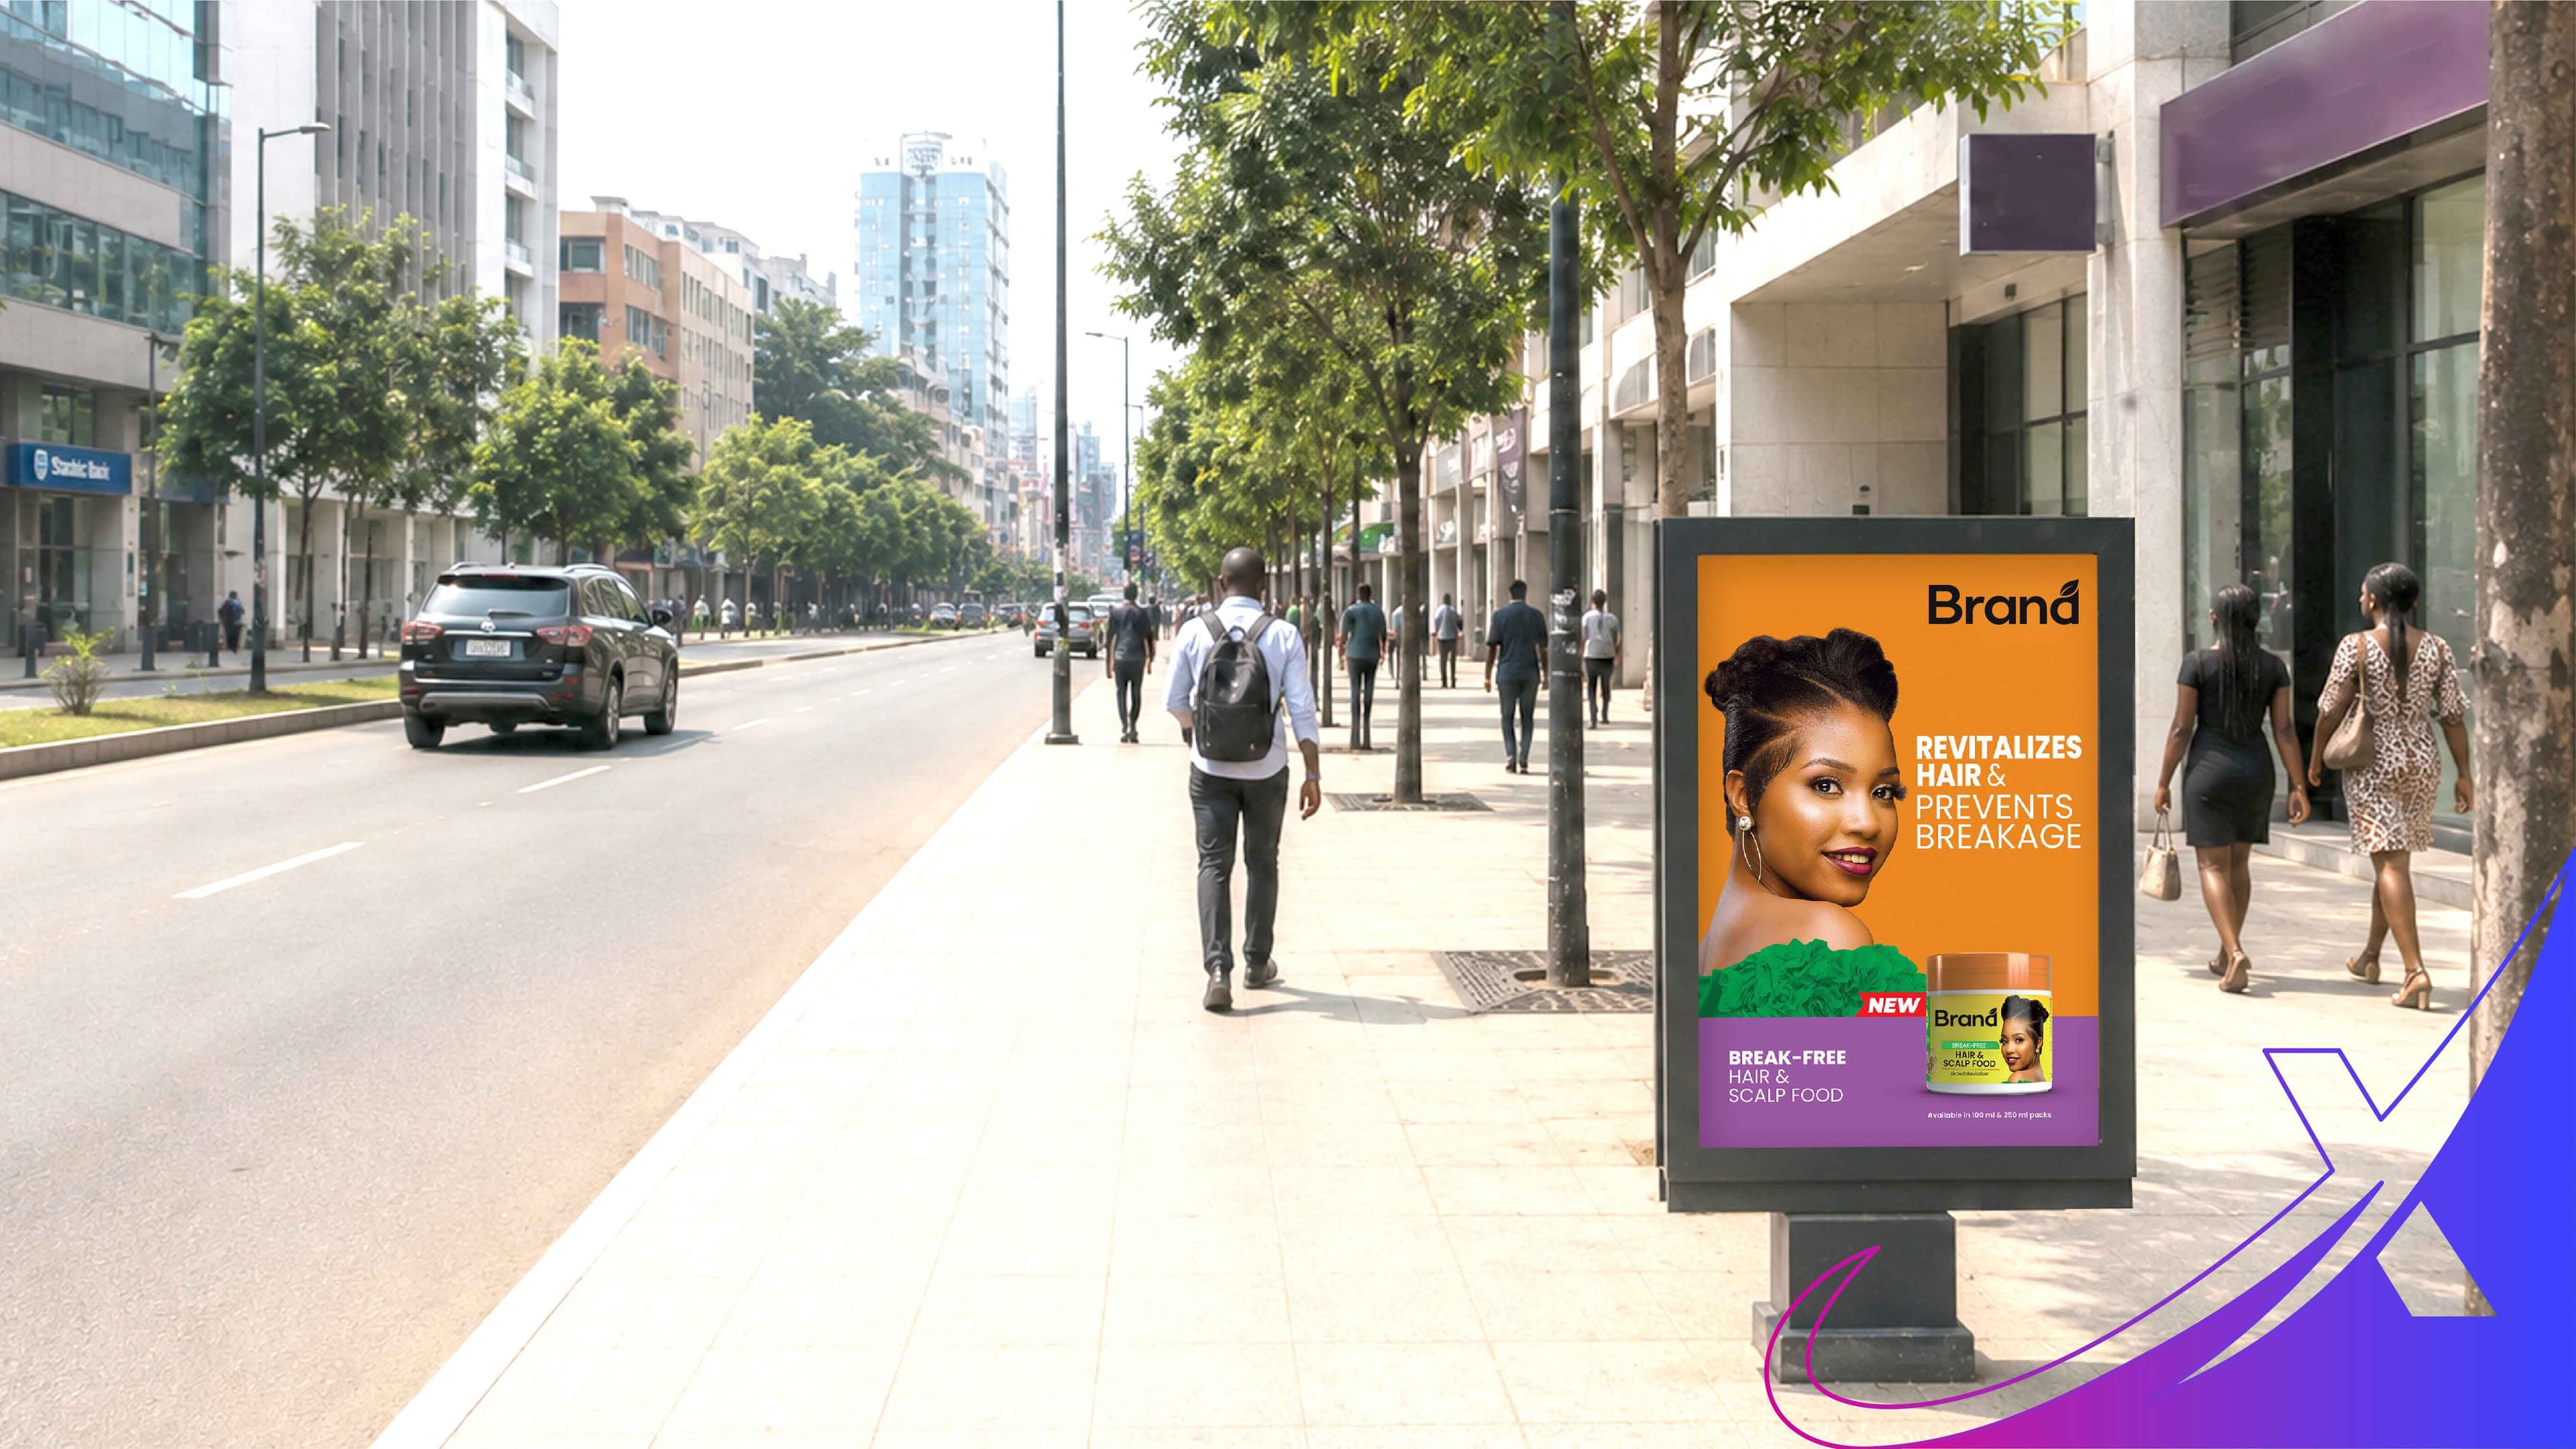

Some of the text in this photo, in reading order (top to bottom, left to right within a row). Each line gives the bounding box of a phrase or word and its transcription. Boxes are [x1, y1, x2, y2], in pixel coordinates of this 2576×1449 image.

[1928, 579, 2079, 625] Brand
[1917, 735, 2082, 760] REVITALIZES
[1917, 763, 2006, 787] HAIR &
[1917, 794, 2073, 820] PREVENTS
[1917, 823, 2082, 849] BREAKAGE
[1868, 997, 1921, 1014] NEW
[1935, 1008, 1997, 1027] Brand
[1729, 1050, 1847, 1065] BREAK-FREE
[1943, 1059, 1970, 1067] SCALP
[1955, 1051, 1984, 1059] HAIR &
[1729, 1069, 1790, 1084] HAIR &
[1729, 1088, 1843, 1103] SCALP FOOD
[2029, 1112, 2052, 1120] packs
